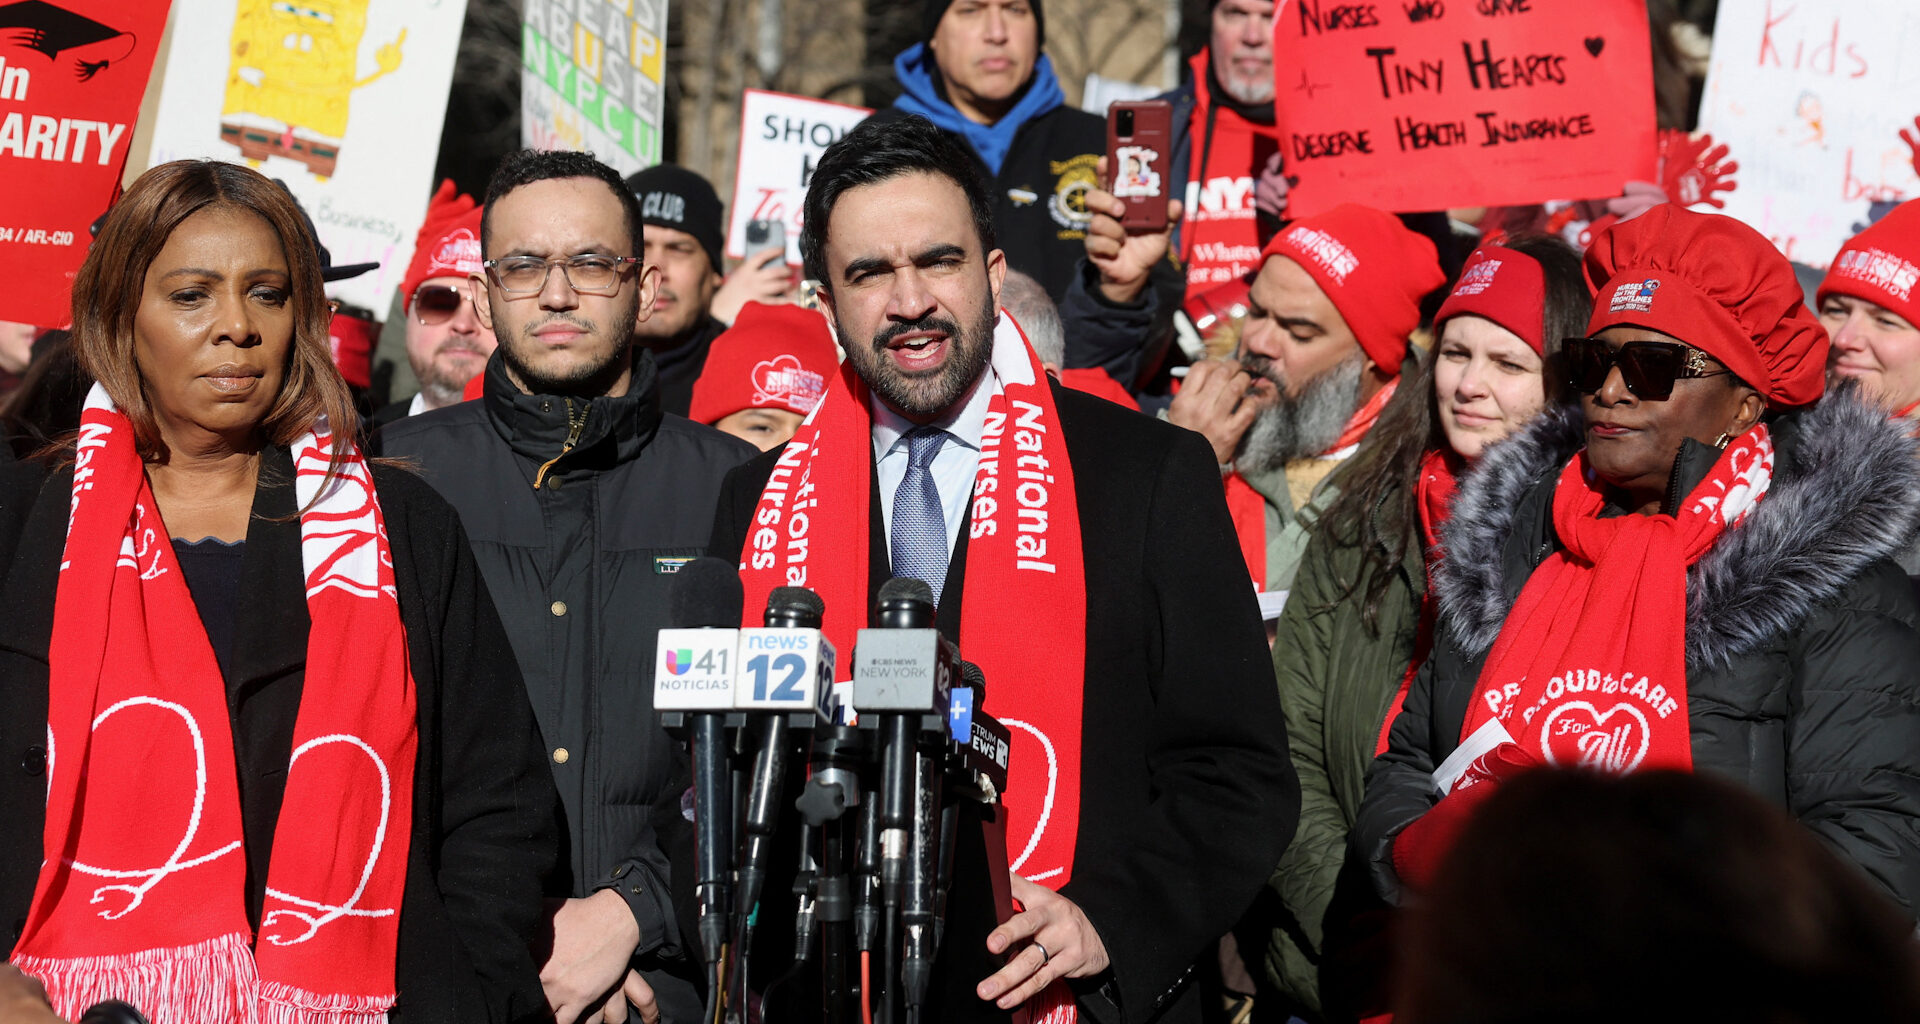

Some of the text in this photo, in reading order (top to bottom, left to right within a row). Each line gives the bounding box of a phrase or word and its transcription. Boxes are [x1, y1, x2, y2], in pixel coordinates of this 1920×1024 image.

[1758, 0, 1869, 79] Kids
[1365, 38, 1568, 99] TINY HEARTS
[763, 114, 846, 148] SHO
[1292, 129, 1374, 162] DESERVE
[24, 229, 74, 246] AFL-CIO
[970, 411, 1008, 539] Nurses
[1012, 400, 1056, 574] National
[752, 441, 809, 570] Nurses
[749, 634, 809, 649] news
[695, 648, 729, 675] 41
[747, 653, 807, 701] 12
[860, 667, 928, 678] NEW YORK
[660, 679, 730, 691] NOTICIAS
